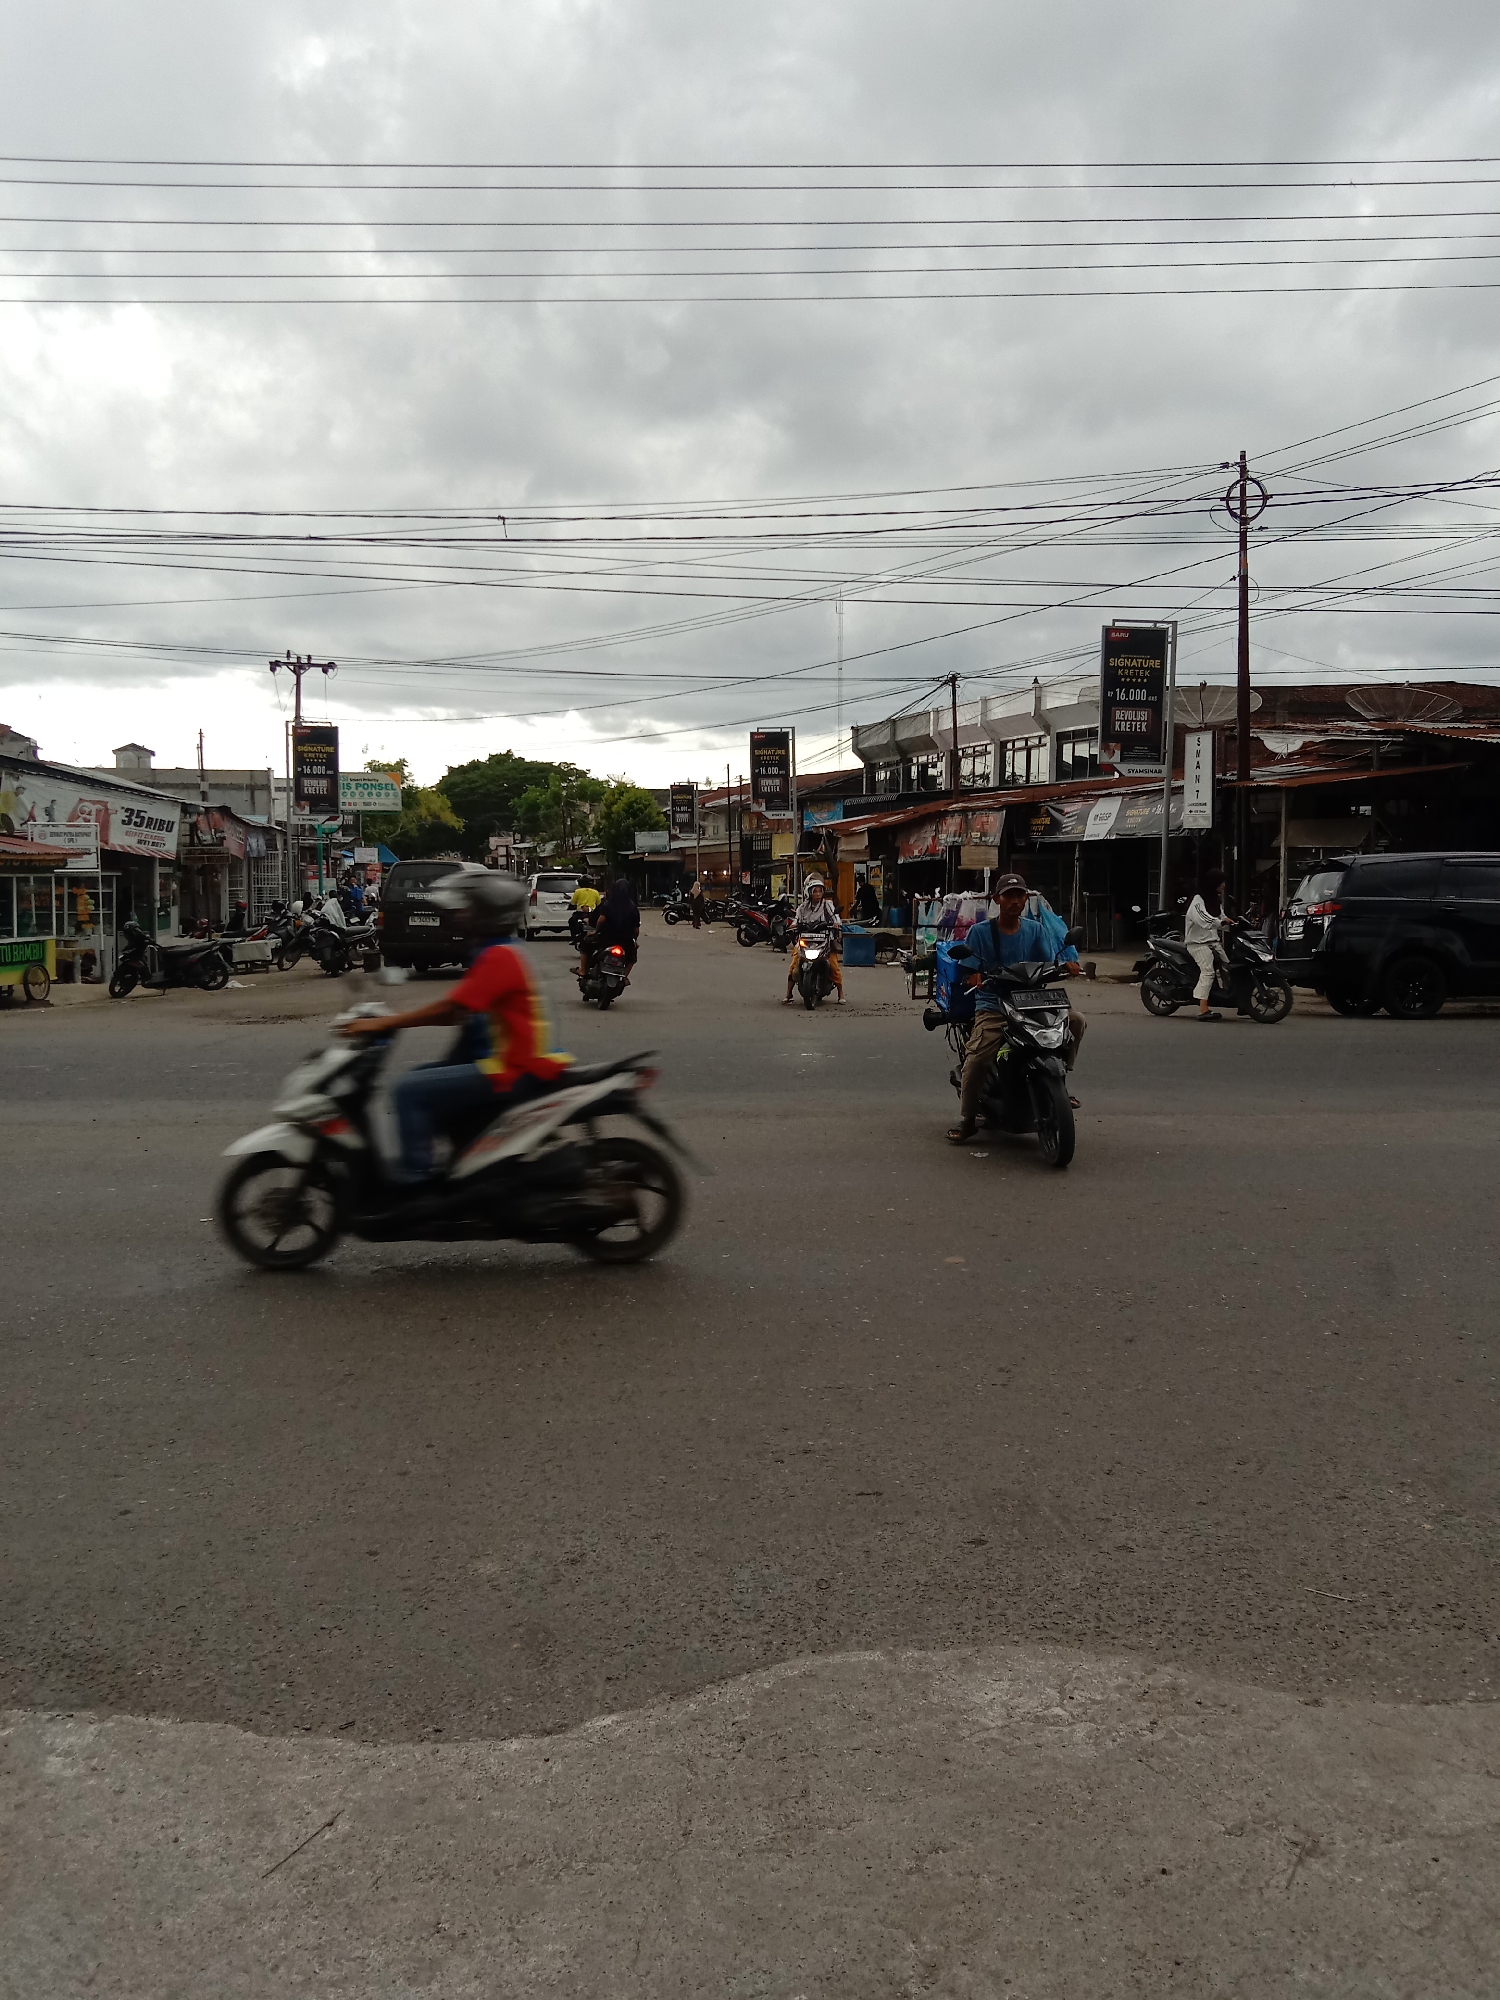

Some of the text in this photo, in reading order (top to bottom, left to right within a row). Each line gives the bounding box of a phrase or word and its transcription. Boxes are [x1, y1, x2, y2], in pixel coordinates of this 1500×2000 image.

[1109, 657, 1161, 669] SIGNATURE
[1117, 669, 1151, 677] KRETEK
[1115, 688, 1147, 701] 16.000
[1115, 710, 1148, 721] REVOLUSI
[1114, 721, 1147, 732] KRETEK
[302, 765, 326, 775] 16.000
[760, 766, 779, 775] 16.000
[355, 782, 397, 791] PONSEL
